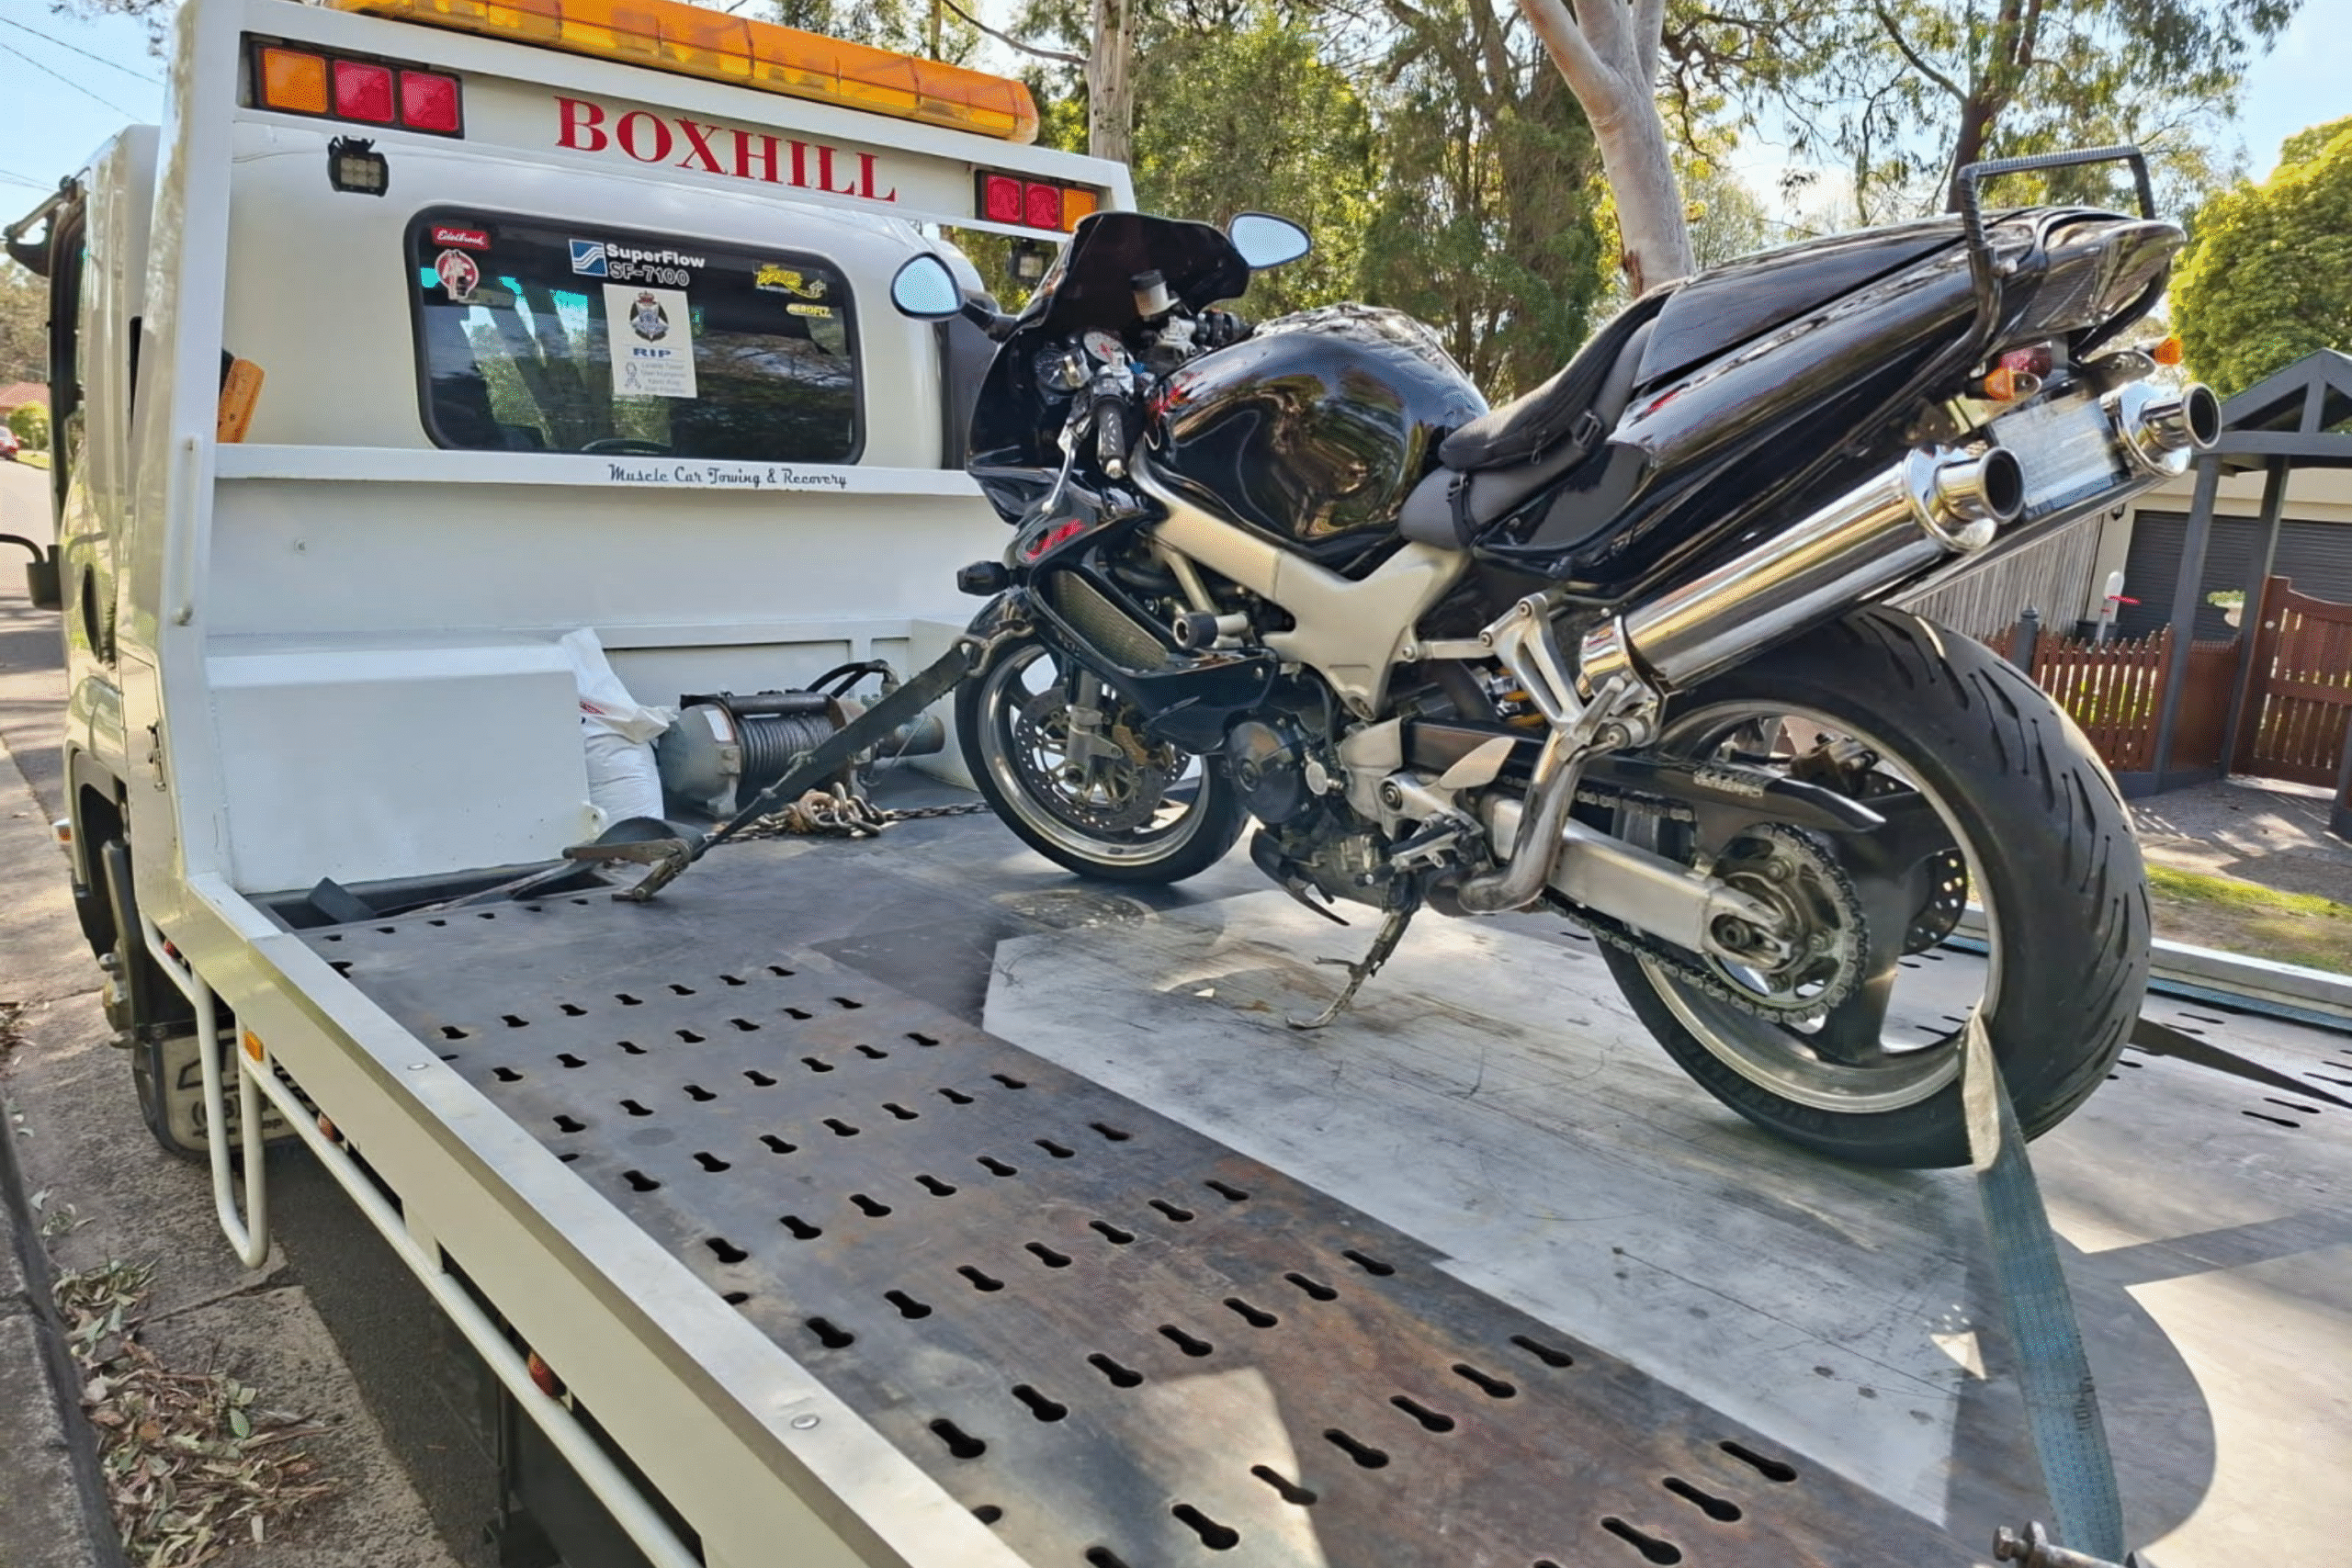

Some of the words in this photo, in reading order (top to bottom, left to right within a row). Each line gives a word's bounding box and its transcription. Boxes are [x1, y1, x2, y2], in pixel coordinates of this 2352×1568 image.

[553, 95, 897, 203] BOXHILL
[605, 243, 706, 268] SuperFlow
[608, 261, 690, 288] SF-7100
[632, 347, 672, 358] RIP
[608, 463, 669, 482] Muscle
[673, 466, 703, 483] Car
[707, 467, 761, 489] Towing
[766, 467, 777, 484] &
[781, 468, 847, 490] Recovery
